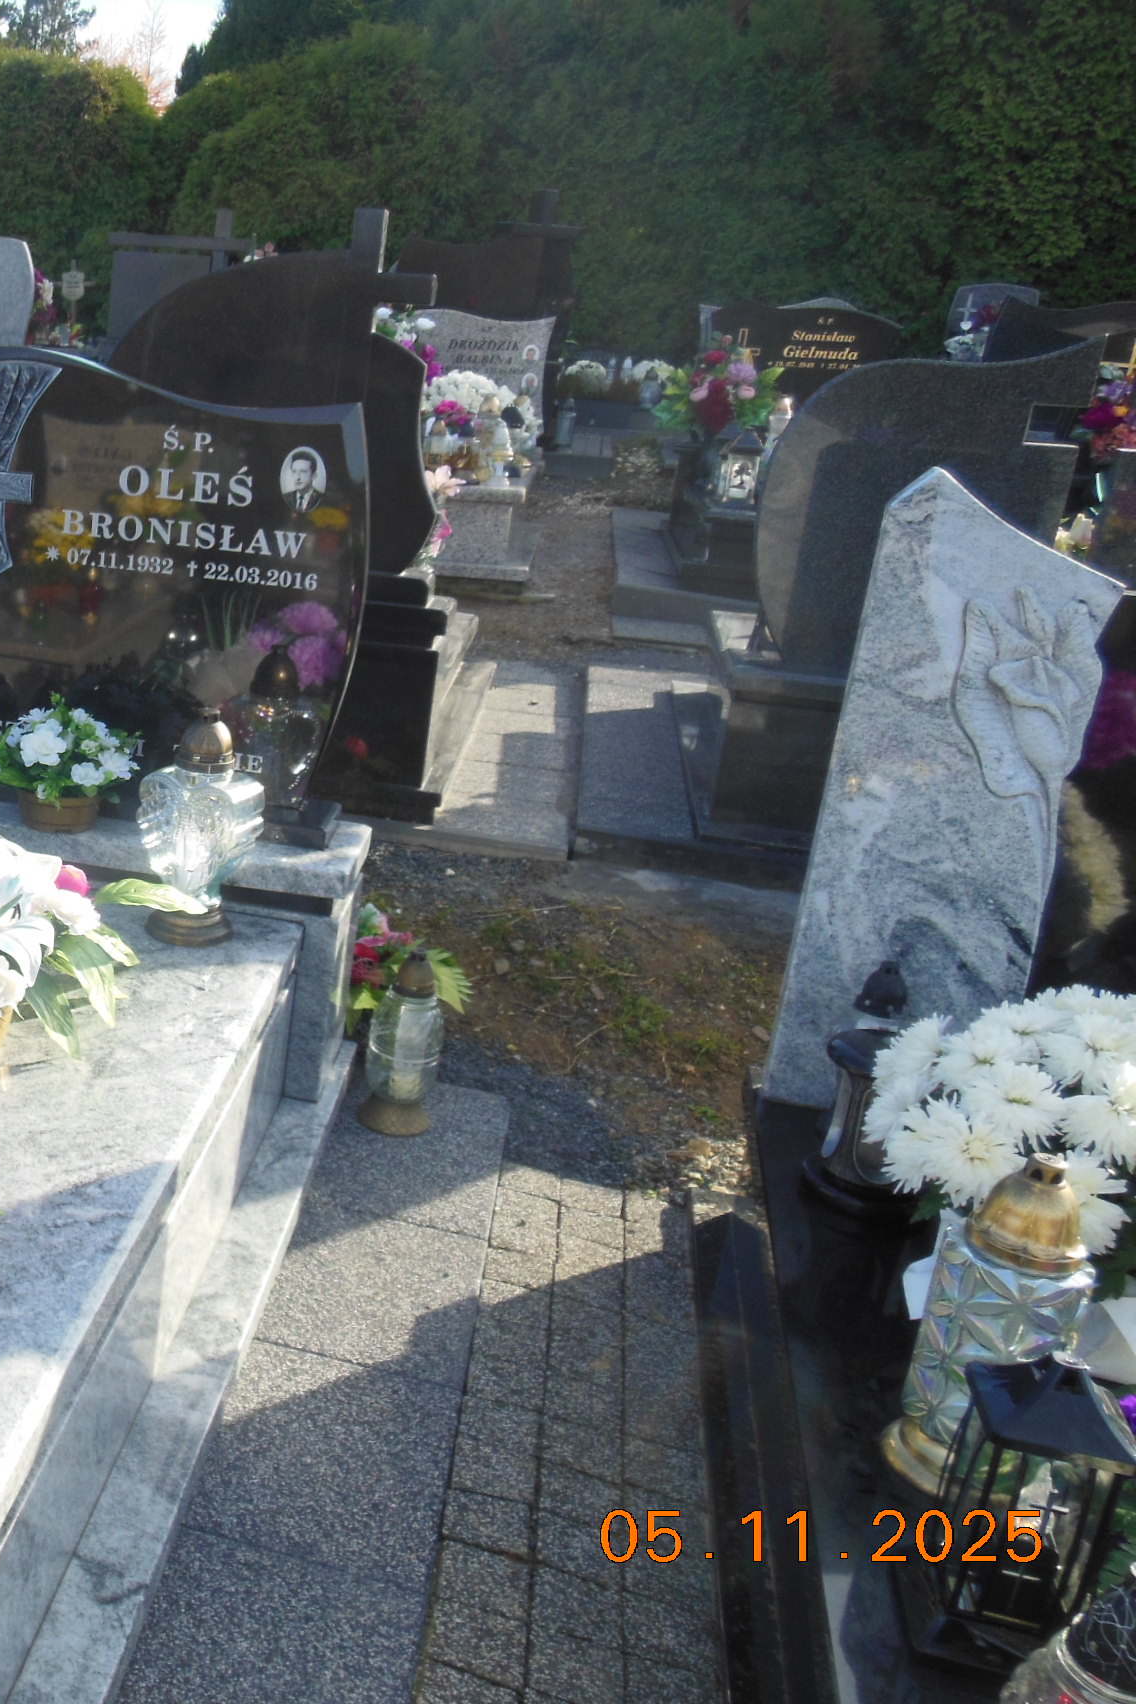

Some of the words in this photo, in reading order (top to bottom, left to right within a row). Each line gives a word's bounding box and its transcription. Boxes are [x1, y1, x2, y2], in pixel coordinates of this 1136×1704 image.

[163, 424, 184, 450] Ś.
[193, 431, 214, 453] P.
[119, 465, 254, 507] OLEŚ
[60, 509, 308, 559] BRONISŁAW
[66, 547, 174, 575] 07.11.1932
[203, 562, 318, 591] 22.03.2016
